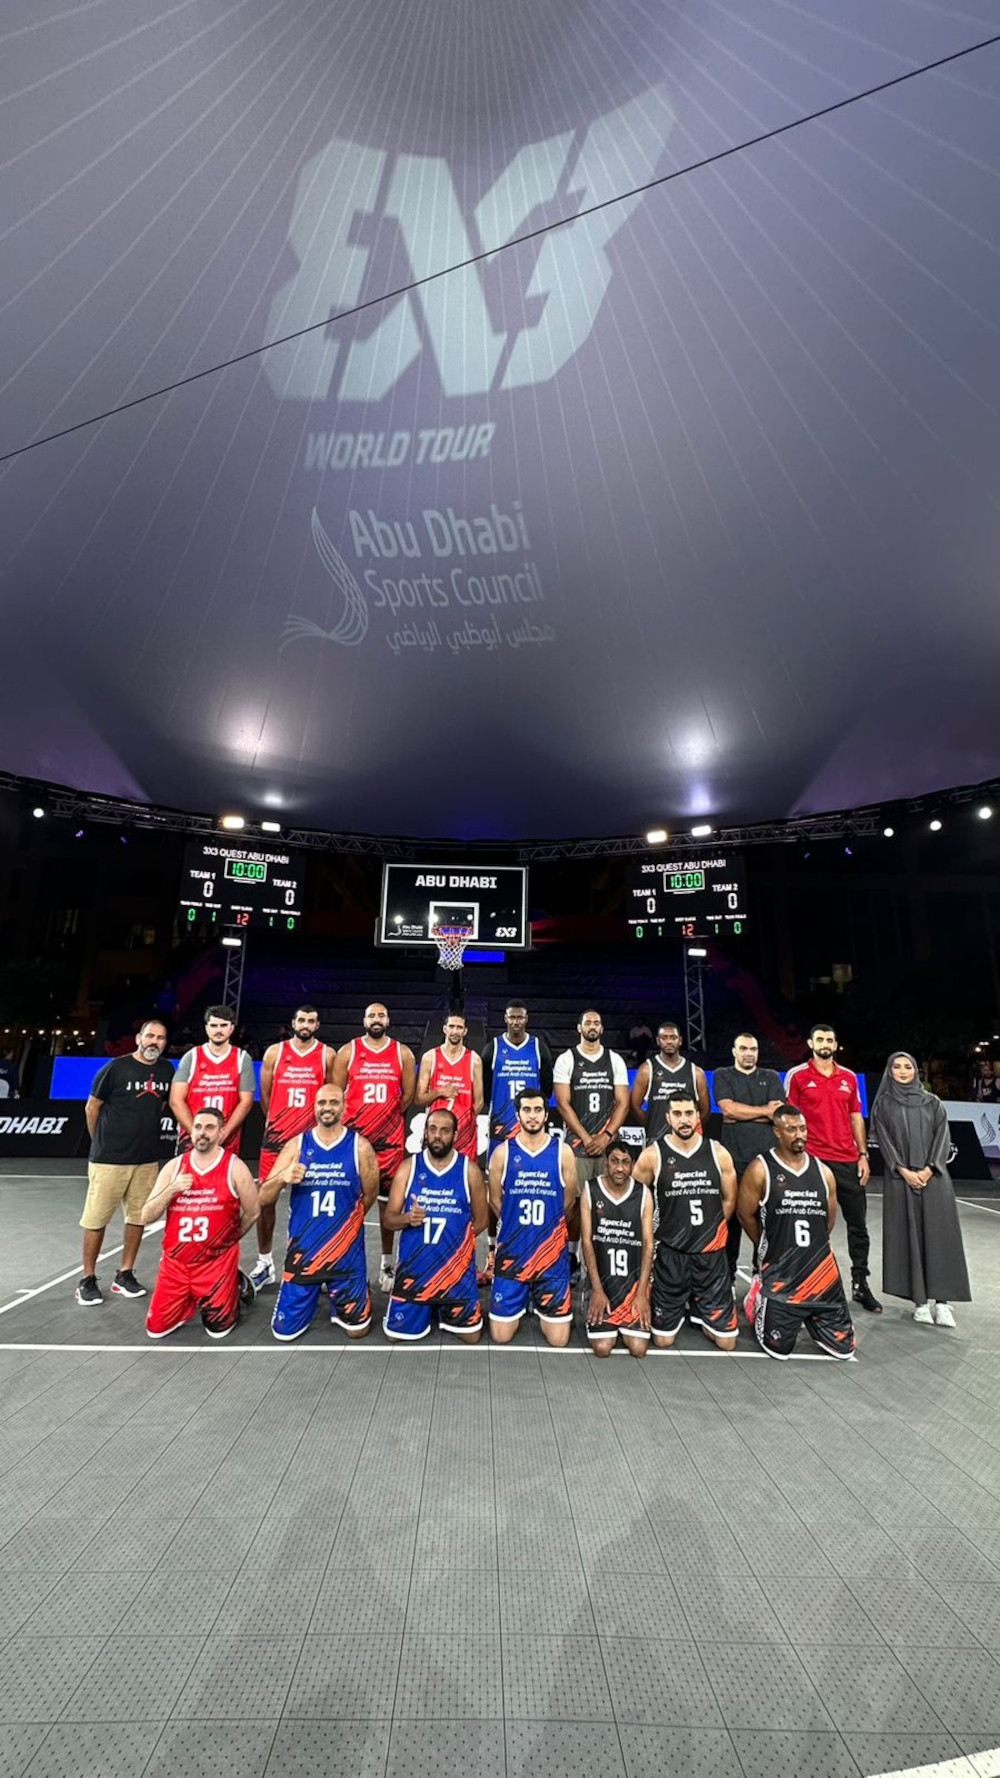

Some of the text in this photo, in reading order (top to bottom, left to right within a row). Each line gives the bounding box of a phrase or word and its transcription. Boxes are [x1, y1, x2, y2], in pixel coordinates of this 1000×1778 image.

[303, 421, 497, 472] WORLD TOUR
[350, 500, 530, 558] Abu Dhabi
[364, 562, 546, 616] Sports Council
[203, 846, 289, 864] 3X3 QUEST ABU DHABI
[232, 862, 264, 878] 10:00
[641, 859, 726, 873] 3X3 QUEST ABU DHABI
[190, 870, 209, 879] TEAM
[671, 873, 702, 888] 10:00
[203, 881, 214, 897] 0
[272, 879, 291, 888] TEAM
[415, 875, 497, 889] ABU DHABI
[712, 883, 732, 892] TEAM
[285, 889, 295, 905] 0
[633, 889, 651, 897] TEAM
[646, 897, 656, 914] 0
[728, 893, 738, 909] 0
[187, 908, 196, 921] 0
[237, 913, 249, 925] 12
[287, 917, 295, 930] 0
[682, 923, 694, 936] 12
[733, 921, 742, 934] 0
[636, 926, 643, 938] 0
[363, 1082, 387, 1104] 20
[508, 1080, 526, 1100] 15
[203, 1095, 223, 1111] 10
[287, 1087, 306, 1108] 15
[589, 1092, 600, 1113] 8
[0, 1117, 69, 1134] DHABI
[309, 1162, 343, 1171] Special
[304, 1170, 346, 1179] Olympics
[518, 1170, 549, 1179] Special
[674, 1170, 707, 1179] Special
[514, 1179, 551, 1188] Olympics
[671, 1178, 712, 1188] Olympics
[421, 1187, 454, 1196] Special
[784, 1189, 818, 1198] Special
[310, 1190, 336, 1217] 14
[417, 1195, 457, 1205] Olympics
[781, 1198, 821, 1207] Olympics
[519, 1198, 545, 1226] 30
[689, 1199, 704, 1226] 5
[178, 1216, 209, 1242] 23
[600, 1217, 632, 1228] Special
[423, 1217, 447, 1244] 17
[597, 1226, 635, 1237] Olympics
[794, 1219, 811, 1247] 6
[607, 1248, 628, 1277] 19
